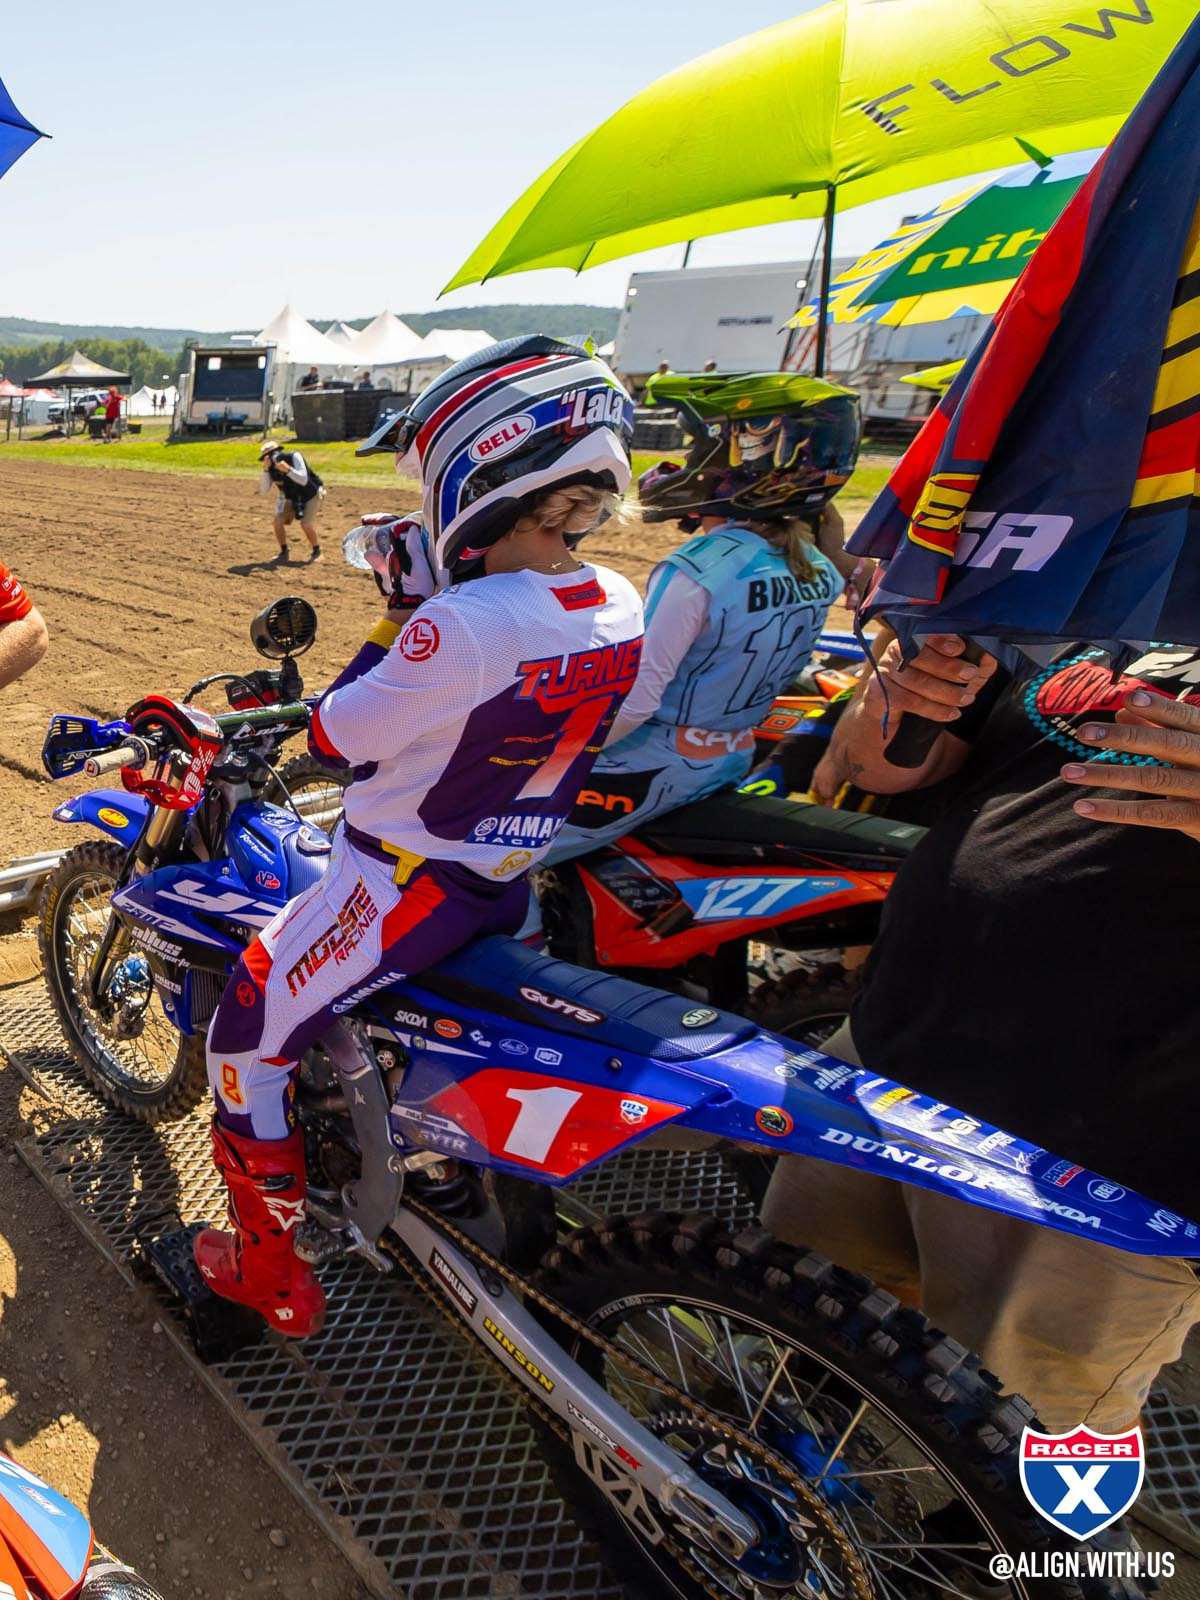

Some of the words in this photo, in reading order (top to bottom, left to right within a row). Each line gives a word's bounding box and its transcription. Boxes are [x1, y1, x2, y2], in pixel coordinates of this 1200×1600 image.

[861, 0, 1154, 135] FLOW
[907, 228, 1051, 275] nih
[477, 422, 527, 457] BELL
[514, 634, 645, 700] TURNE
[68, 752, 92, 760] ASV
[475, 837, 548, 847] RACI
[497, 816, 565, 838] YAMA
[693, 878, 807, 920] 127
[334, 903, 379, 967] RACING
[342, 971, 407, 1004] YAMAHA
[520, 987, 601, 1023] GUTS
[503, 1086, 584, 1164] 1
[820, 1128, 1010, 1191] DUNLOP
[432, 1251, 475, 1310] YAMALUBE
[483, 1316, 555, 1393] HINSON
